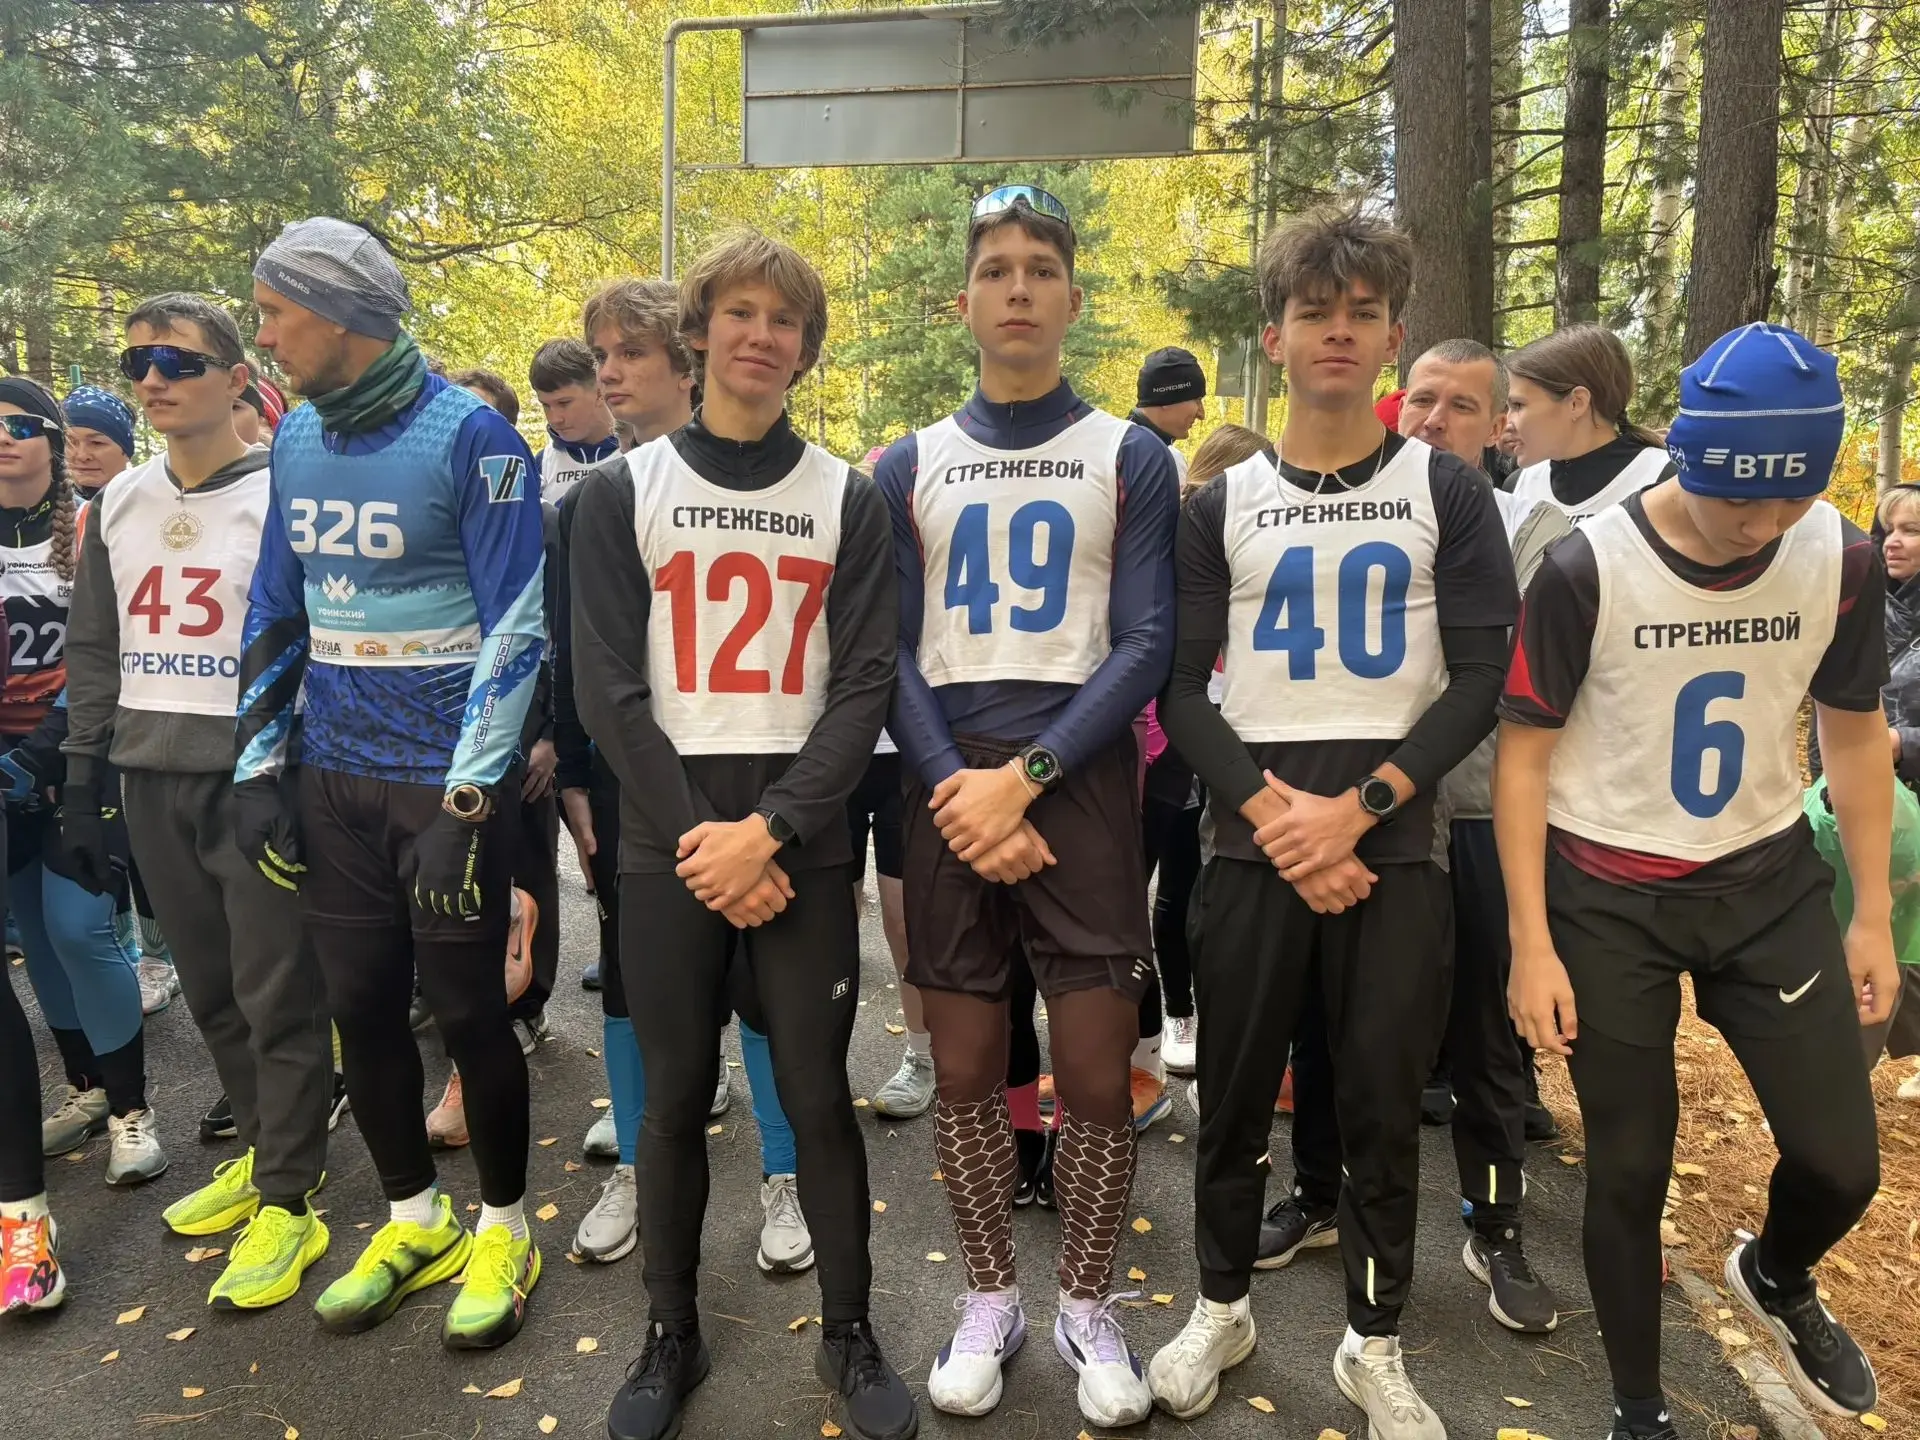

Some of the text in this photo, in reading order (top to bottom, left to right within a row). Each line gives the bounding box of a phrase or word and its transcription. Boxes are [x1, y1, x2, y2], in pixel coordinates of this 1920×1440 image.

[1152, 382, 1192, 393] NORDSKI
[944, 458, 1085, 484] СТРЕЖЕВОЙ
[1734, 452, 1808, 478] ВТБ
[290, 498, 404, 559] 326
[672, 506, 814, 539] СТРЕЖЕВОЙ
[1257, 498, 1412, 528] СТРЕЖЕВОЙ
[944, 500, 1075, 635] 49
[128, 566, 224, 637] 43
[1253, 541, 1412, 680] 40
[654, 551, 835, 694] 127
[1634, 611, 1801, 649] СТРЕЖЕВОЙ
[8, 621, 66, 666] 22
[432, 642, 473, 653] BATYR
[471, 634, 513, 754] VICTORY CODE
[1671, 670, 1746, 819] 6
[463, 853, 476, 890] RUNNING
